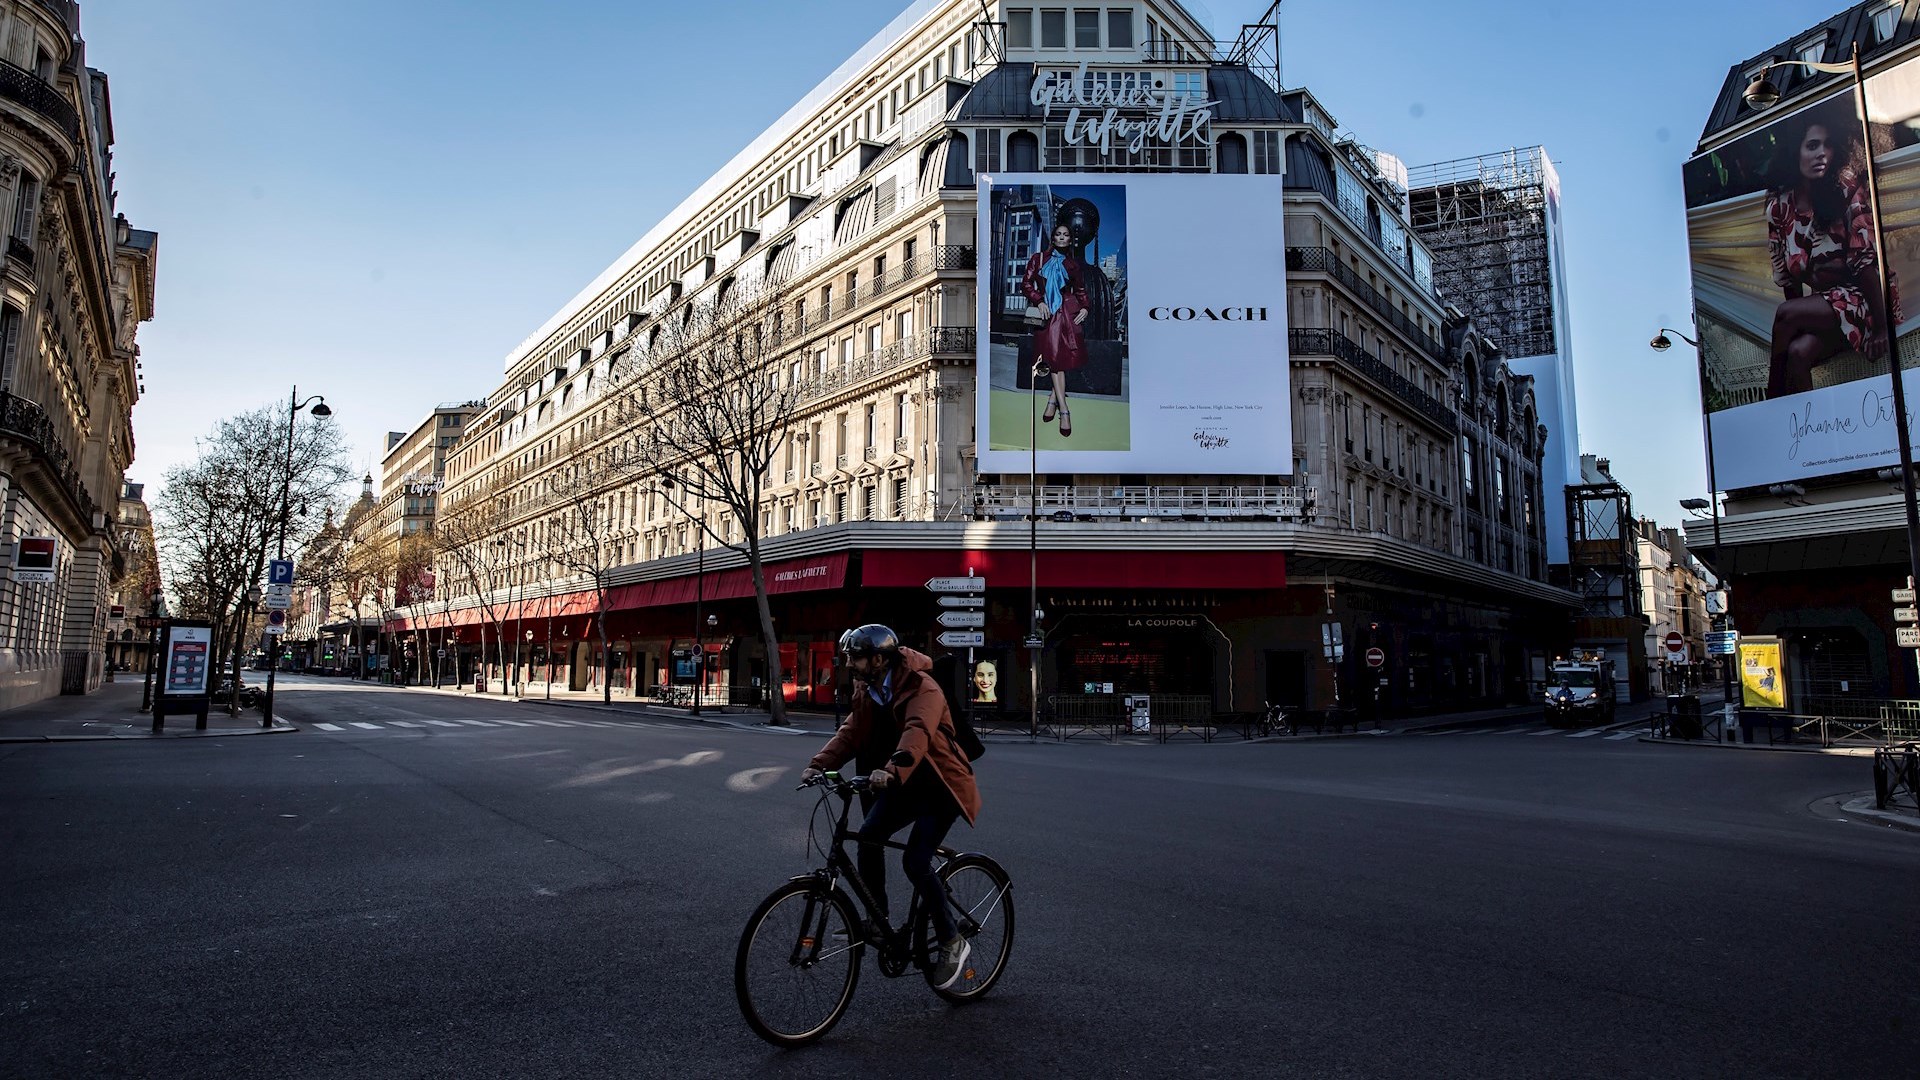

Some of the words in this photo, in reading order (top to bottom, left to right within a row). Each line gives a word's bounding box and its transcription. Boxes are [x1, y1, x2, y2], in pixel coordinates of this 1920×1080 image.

[1031, 60, 1157, 117] Galeries
[1064, 95, 1223, 156] Lafayette
[1149, 307, 1268, 321] COACH
[1193, 430, 1218, 442] Galeries
[1789, 401, 1858, 461] Johanna
[1200, 437, 1230, 450] Lafayette
[1802, 458, 1828, 467] Collection
[1828, 455, 1855, 464] disponible
[276, 565, 287, 580] P
[1127, 619, 1142, 627] LA
[1145, 619, 1198, 627] COUPOLE
